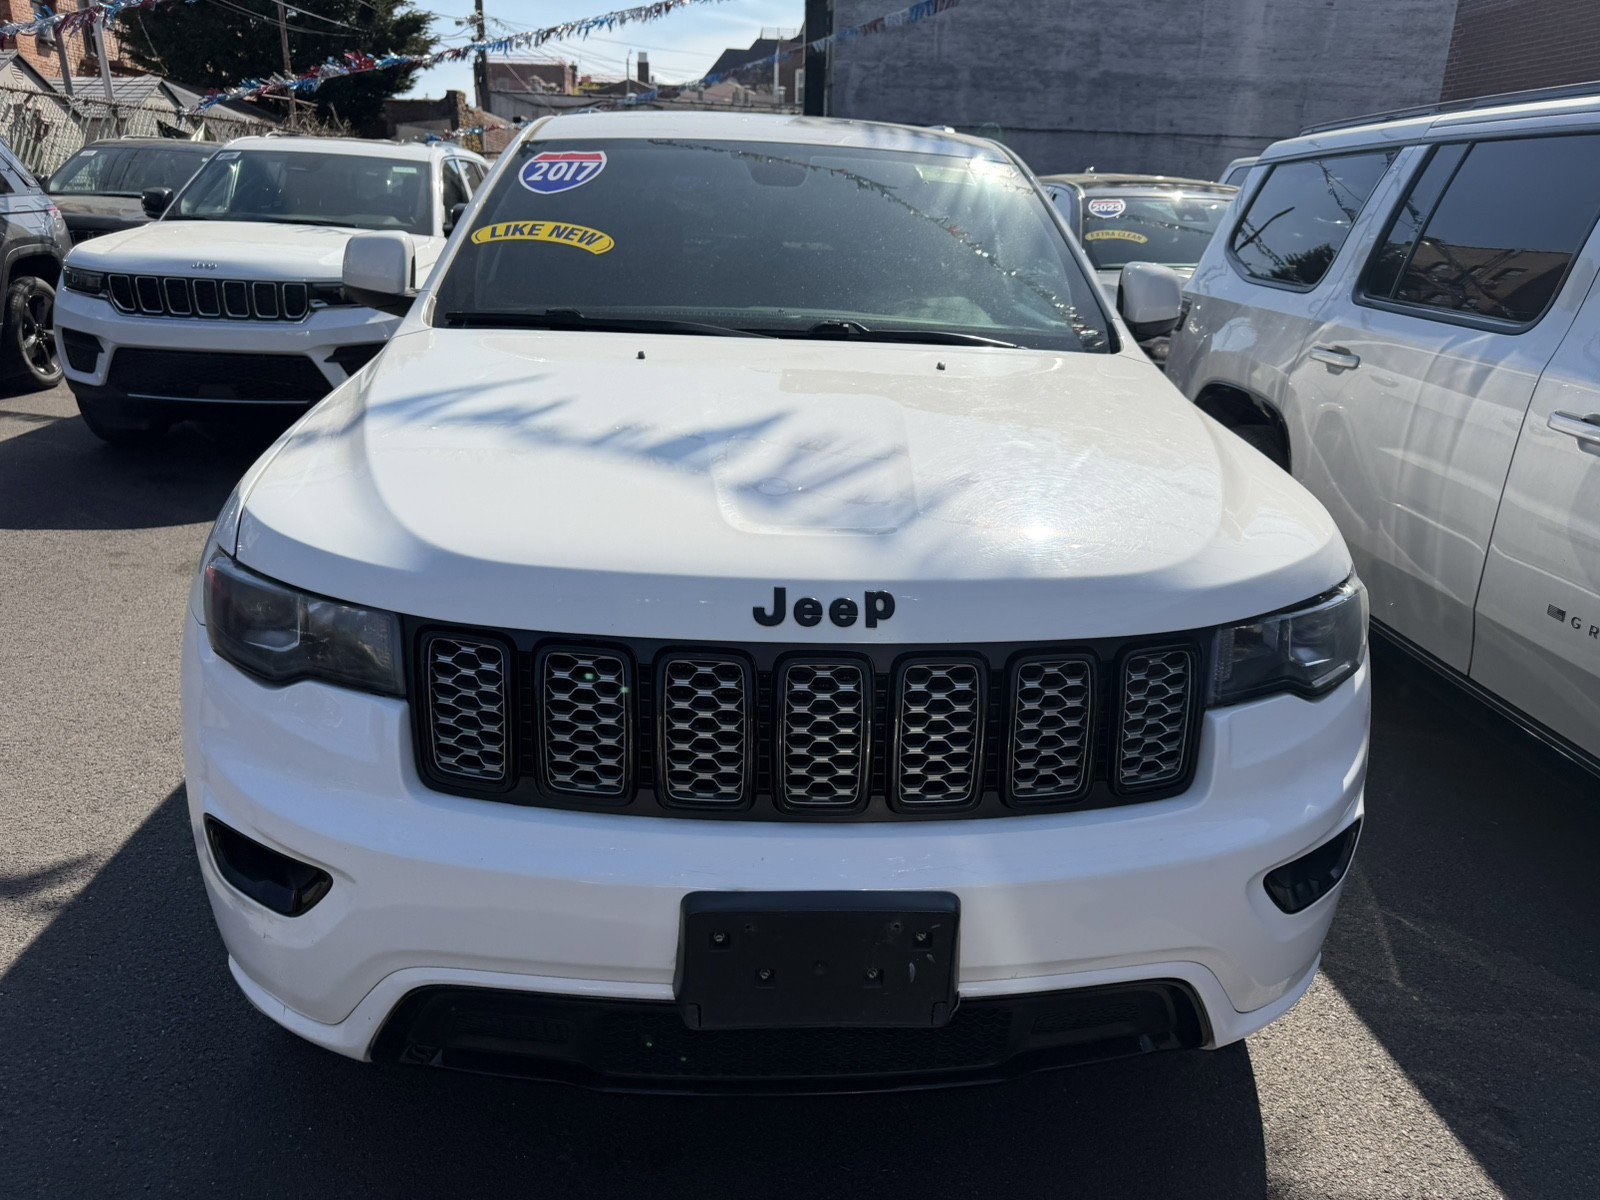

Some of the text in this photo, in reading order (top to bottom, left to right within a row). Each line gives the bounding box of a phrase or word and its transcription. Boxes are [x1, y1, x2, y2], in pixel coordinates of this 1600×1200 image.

[526, 162, 599, 181] 2017
[1092, 203, 1121, 212] 2023
[490, 223, 603, 246] LIKE NEW
[1117, 231, 1142, 241] CLEAN
[753, 587, 895, 628] Jeep
